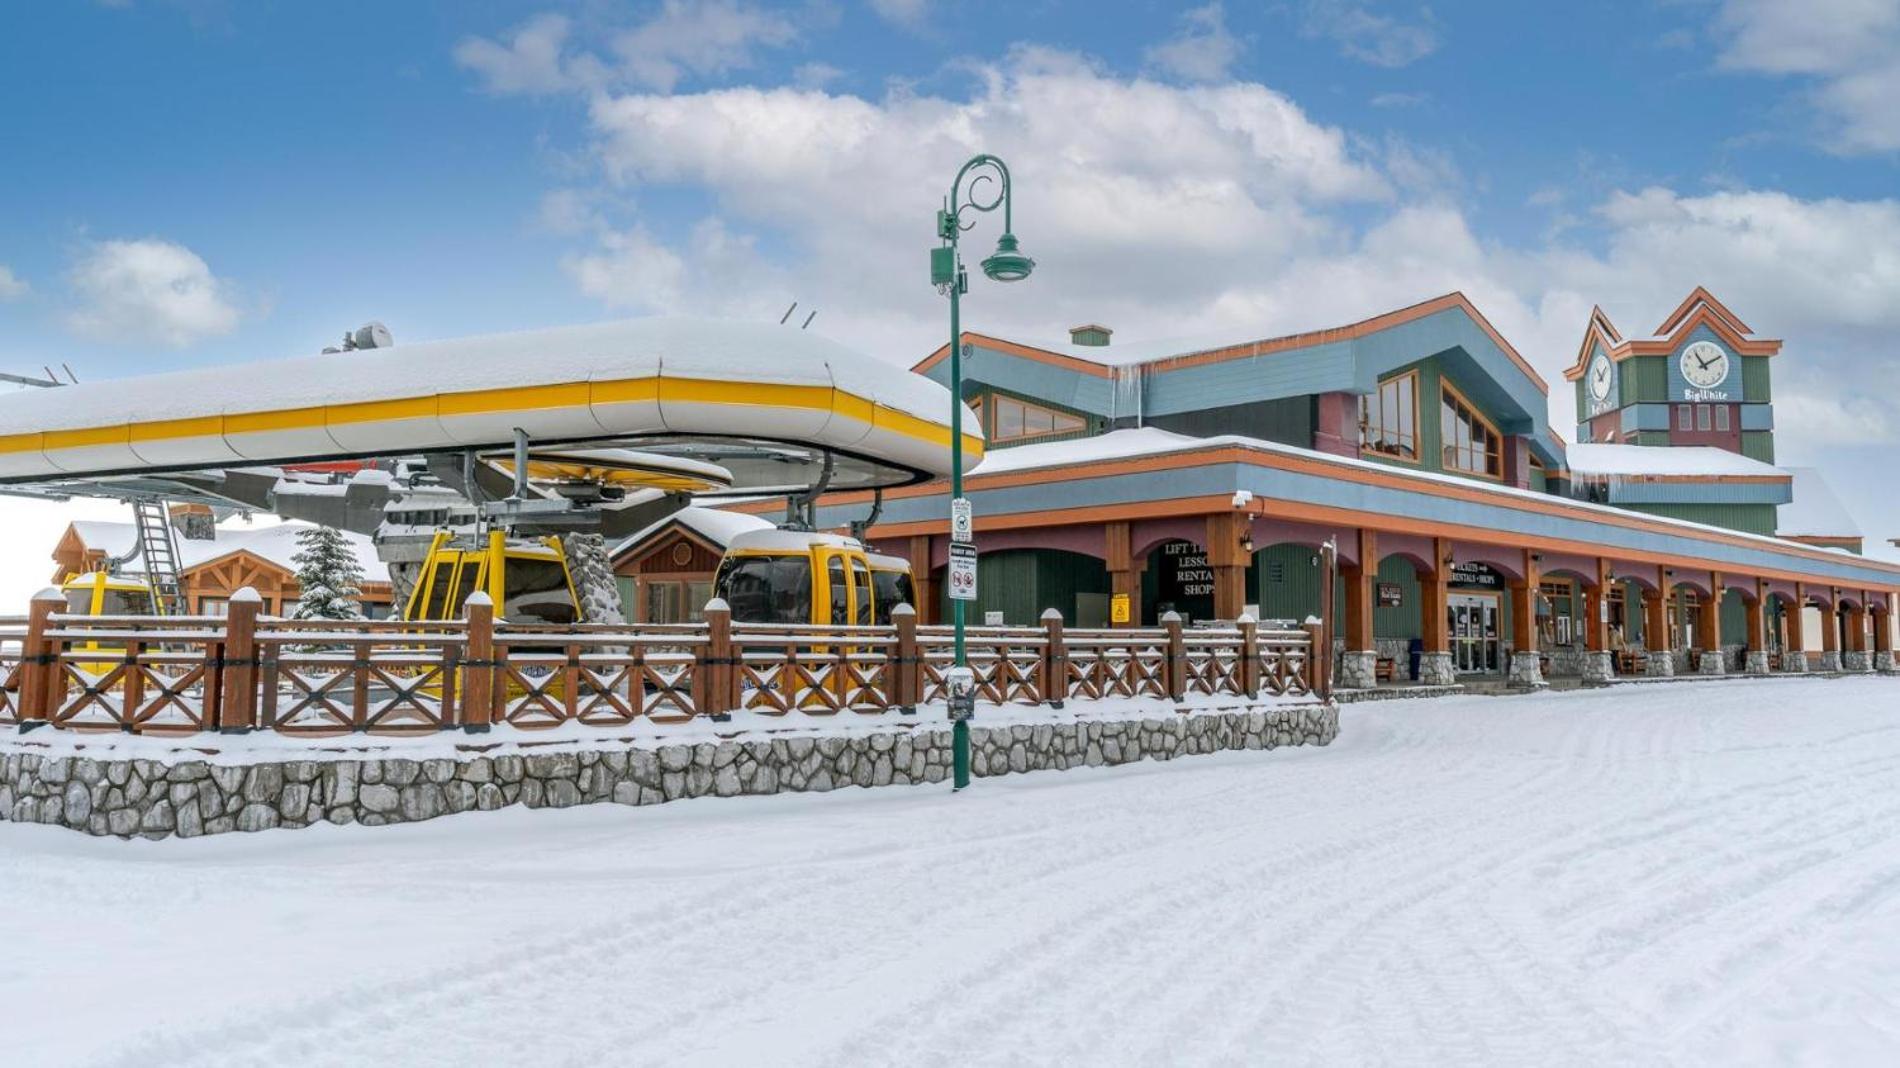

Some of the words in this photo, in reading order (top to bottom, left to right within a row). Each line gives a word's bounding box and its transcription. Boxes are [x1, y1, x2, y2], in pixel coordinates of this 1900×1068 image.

[1165, 543, 1188, 554] LIFT
[1179, 557, 1208, 567] LESSO
[1177, 571, 1213, 581] RENTA
